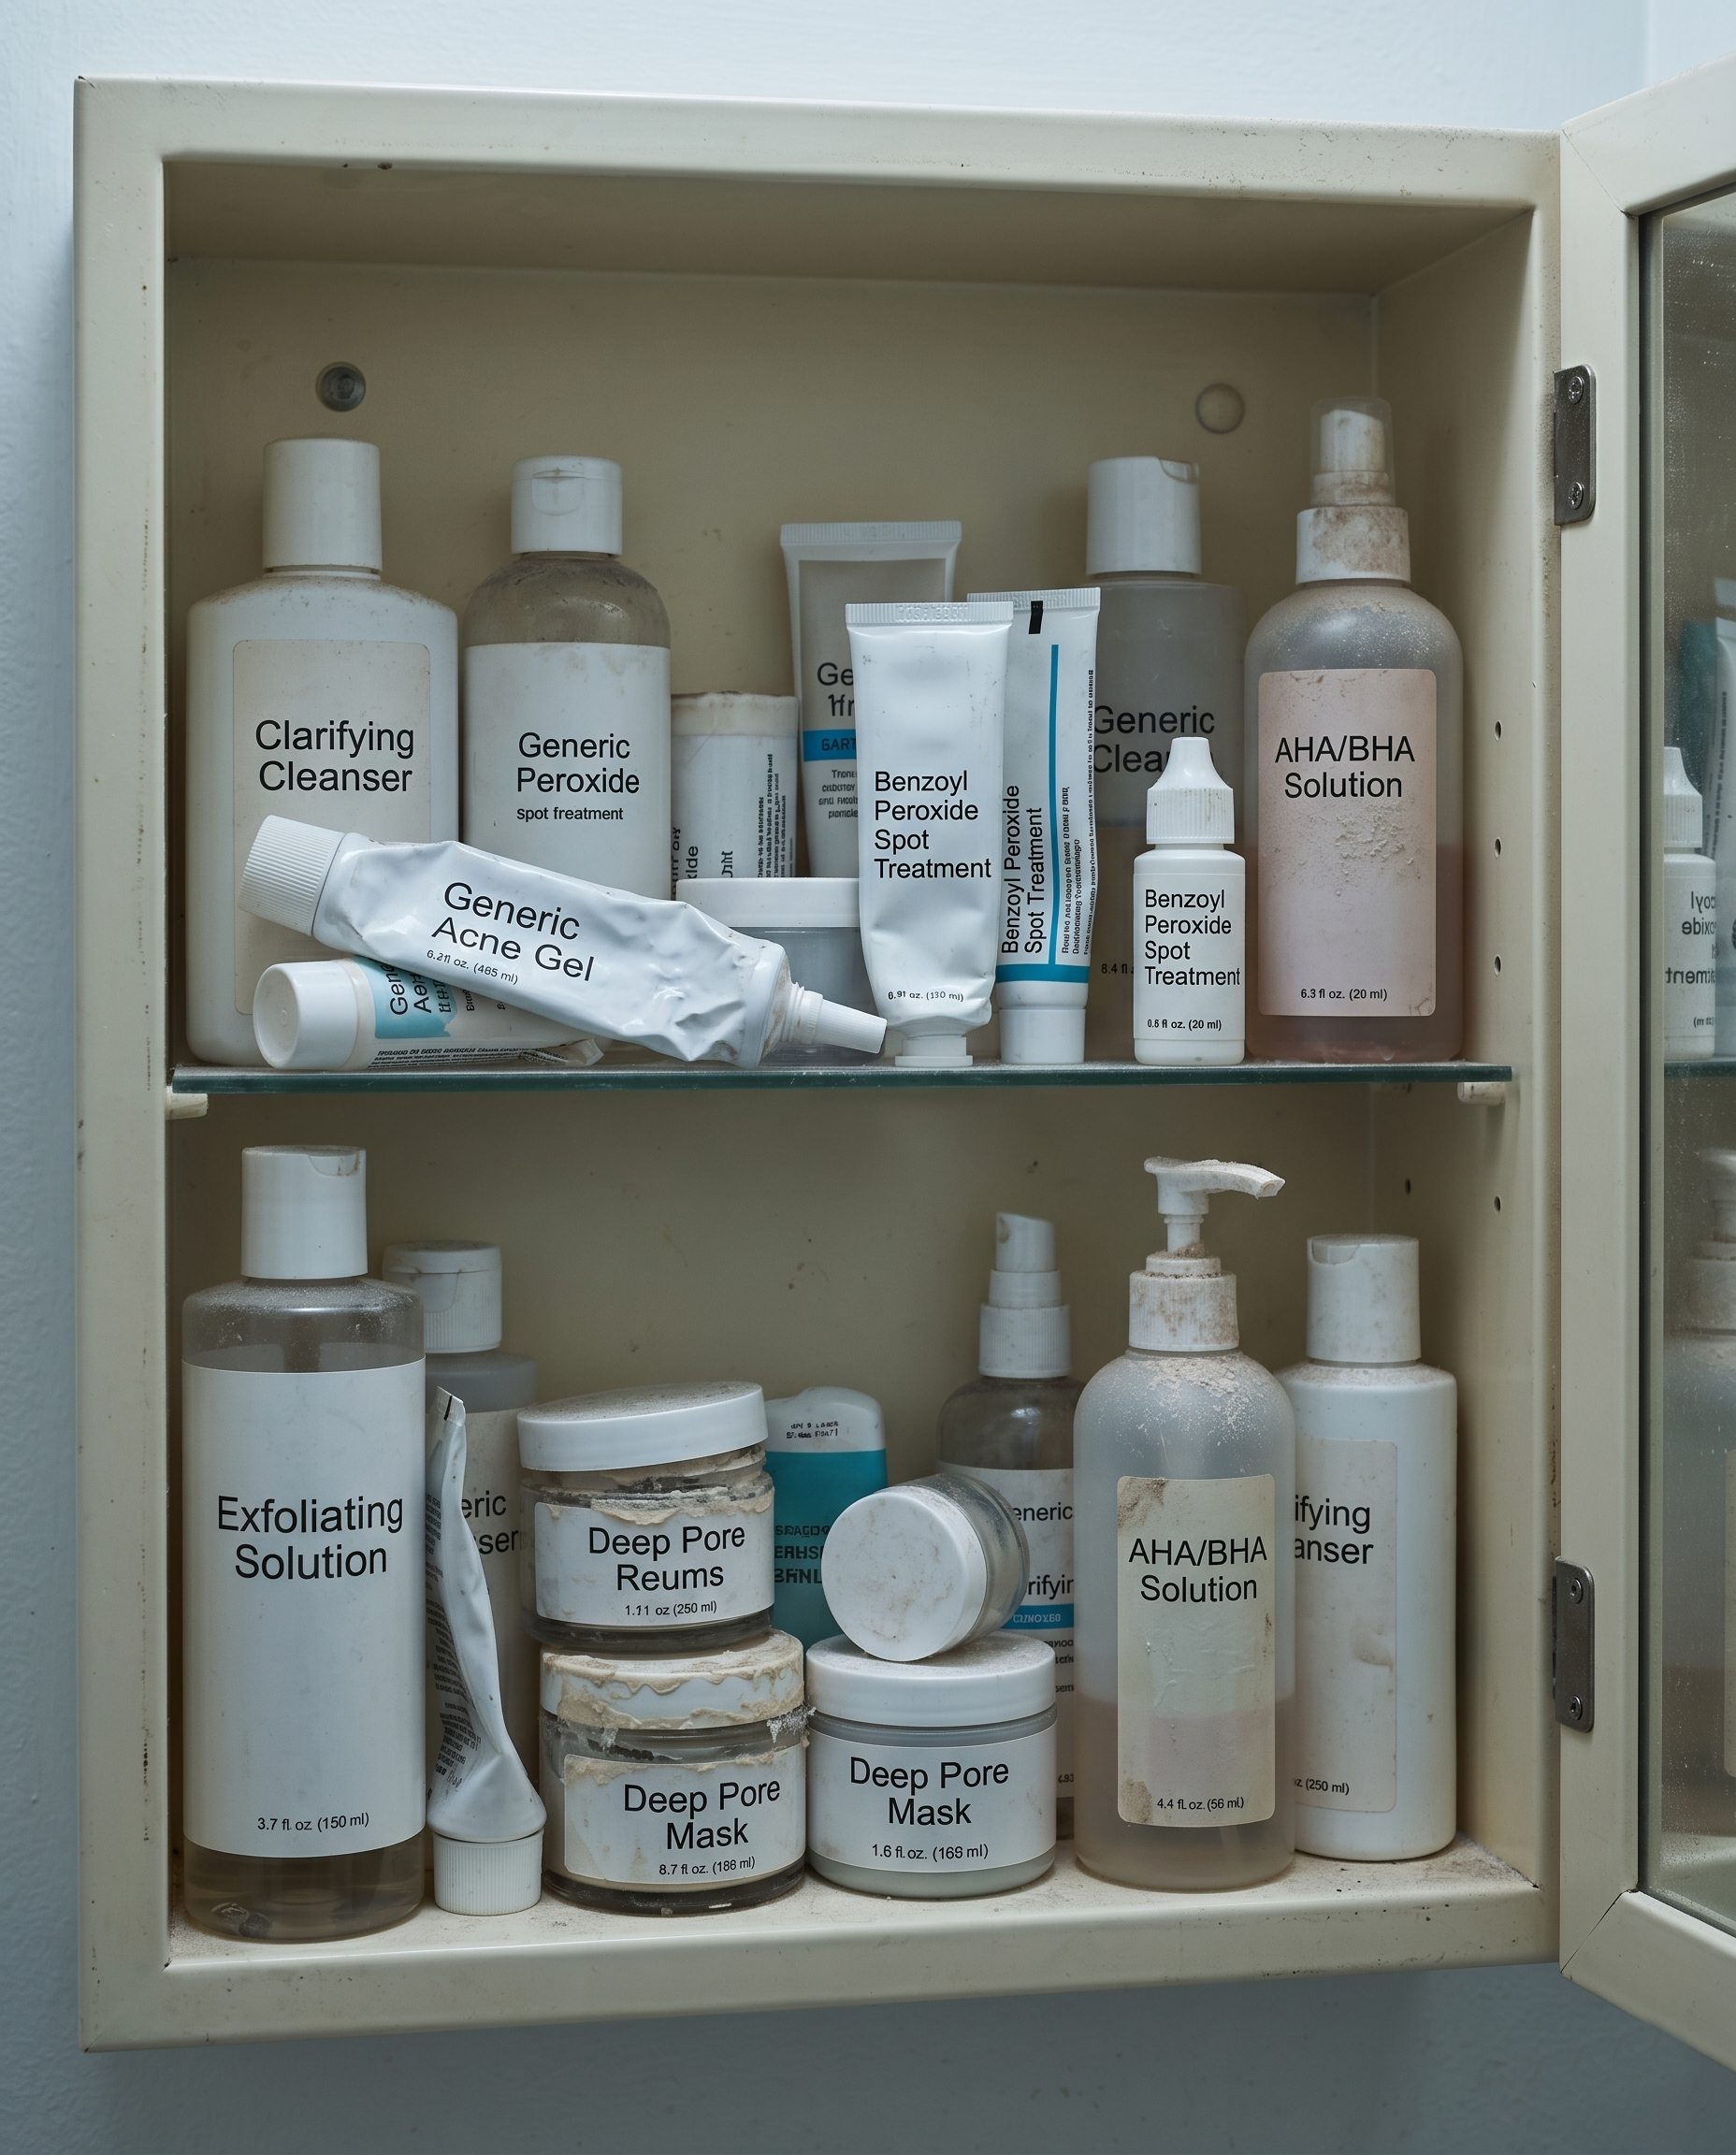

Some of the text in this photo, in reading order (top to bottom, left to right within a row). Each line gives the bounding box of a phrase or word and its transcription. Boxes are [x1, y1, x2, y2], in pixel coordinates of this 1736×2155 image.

[1094, 704, 1215, 734] Generic
[255, 719, 414, 759] Clarifying
[518, 731, 630, 759] Generic
[1275, 735, 1415, 763] AHA/BHA
[259, 759, 413, 792] Cleanser
[517, 767, 640, 793] Peroxide
[875, 770, 968, 796] Benzoyl
[1284, 771, 1402, 798] Solution
[516, 807, 549, 822] spot
[875, 800, 979, 820] Peroxide
[874, 829, 930, 855] Spot
[874, 858, 992, 878] Treatment
[1001, 785, 1025, 953] Benzoyl Peroxide
[1024, 807, 1047, 954] Spot Treatment
[444, 882, 580, 940] Generic
[1144, 889, 1225, 913] Benzoyl
[1144, 916, 1232, 934] Peroxide
[430, 917, 595, 982] Acne Gel
[1144, 940, 1191, 964] Spot
[454, 959, 470, 969] oz.
[500, 973, 518, 986] ml)
[1144, 966, 1241, 986] Treatment
[1301, 988, 1316, 999] 6.3
[1329, 991, 1345, 999] oz.
[1349, 989, 1367, 1002] (20
[1370, 989, 1388, 1002] ml)
[1188, 1020, 1205, 1032] (20
[1207, 1020, 1222, 1032] ml)
[218, 1495, 403, 1534] Exfoliating
[588, 1526, 745, 1562] Deep Pore
[1128, 1536, 1267, 1567] AHA/BHA
[235, 1543, 387, 1580] Solution
[616, 1563, 724, 1591] Reums
[1140, 1574, 1257, 1602] Solution
[655, 1607, 671, 1616] oz
[673, 1602, 698, 1617] (250
[701, 1600, 717, 1613] ml)
[850, 1757, 1009, 1796] Deep Pore
[1305, 1778, 1328, 1791] (250
[1331, 1783, 1350, 1795] ml)
[624, 1780, 781, 1820] Deep Pore
[889, 1797, 972, 1826] Mask
[1156, 1798, 1174, 1809] 4.4
[1207, 1798, 1224, 1812] (56
[1226, 1796, 1245, 1809] ml)
[257, 1817, 279, 1830] 3.7
[317, 1815, 347, 1833] (150
[349, 1812, 369, 1828] ml)
[667, 1817, 749, 1850] Mask
[872, 1844, 892, 1858] 1.6
[966, 1844, 989, 1859] ml)
[659, 1864, 678, 1875] 8.7
[691, 1865, 709, 1874] oz.
[739, 1856, 756, 1873] ml)
